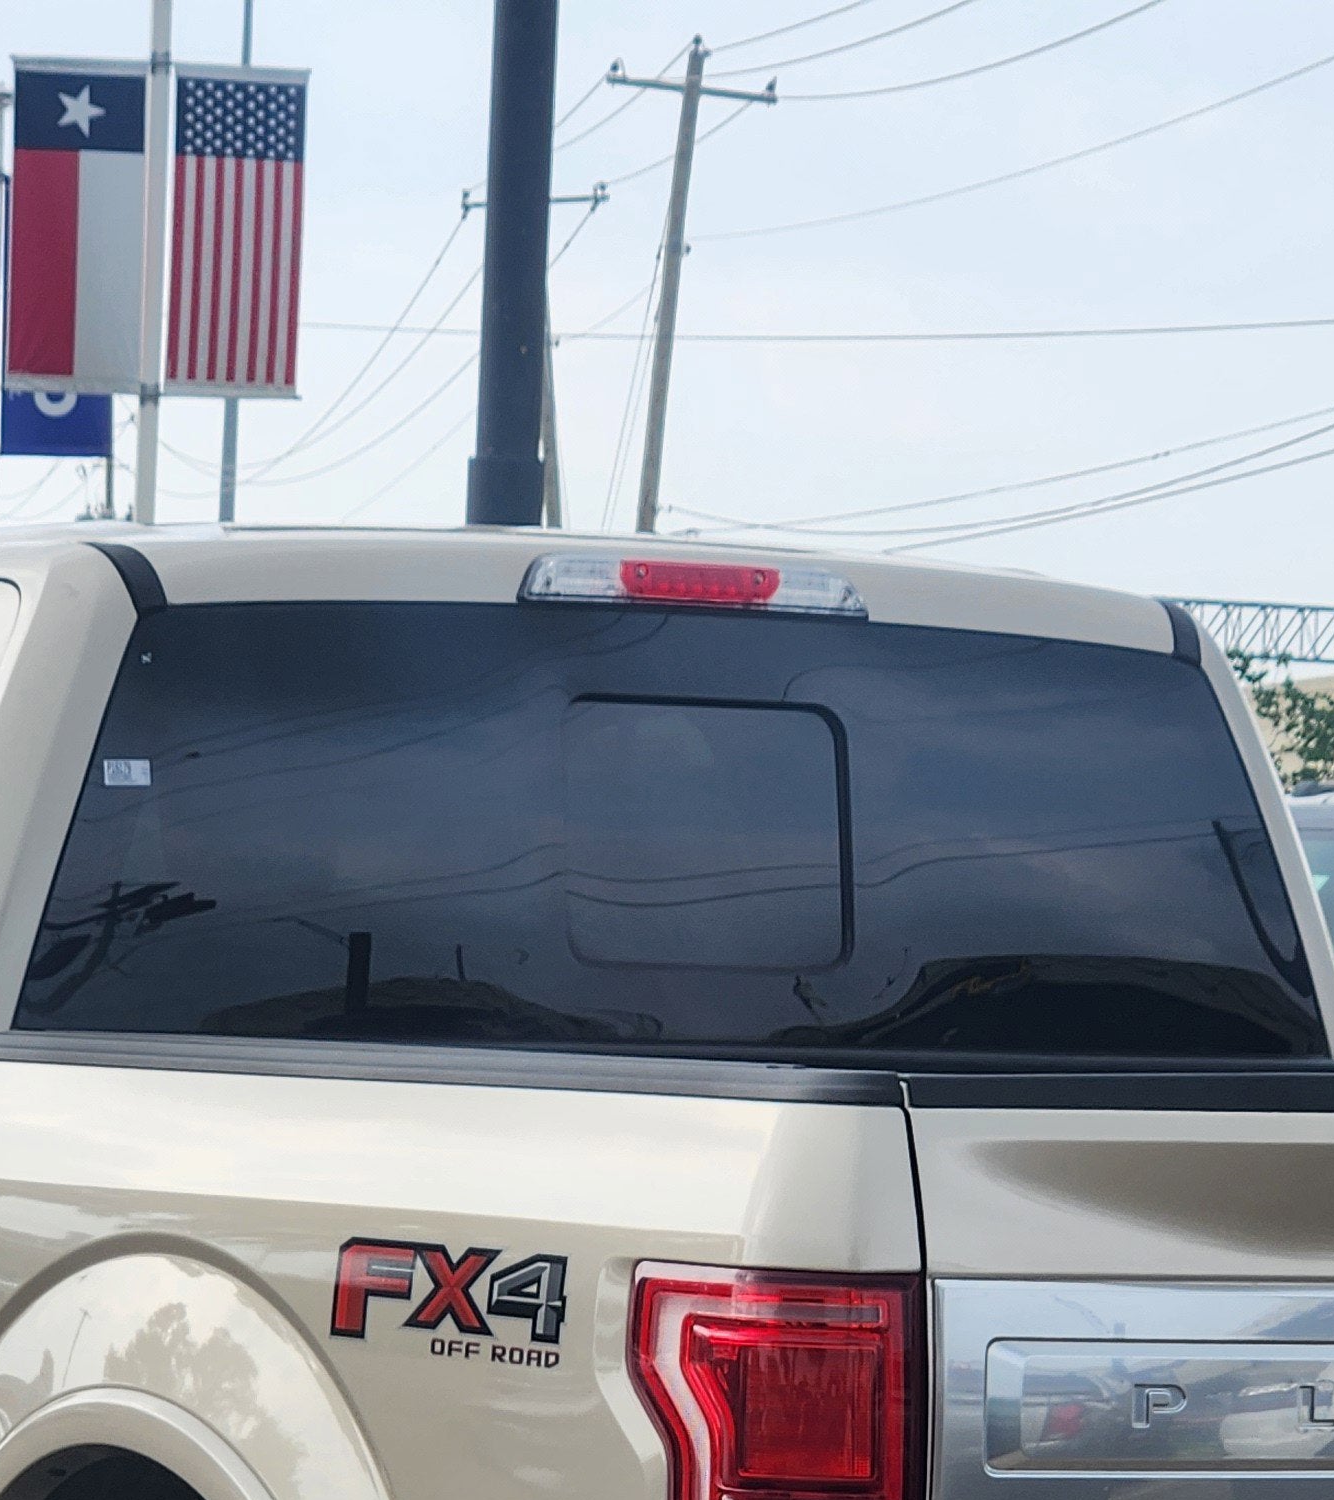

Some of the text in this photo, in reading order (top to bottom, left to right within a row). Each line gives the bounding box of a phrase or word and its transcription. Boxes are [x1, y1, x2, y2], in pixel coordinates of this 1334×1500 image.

[330, 1236, 568, 1345] FX4
[430, 1338, 560, 1368] OFF ROAD
